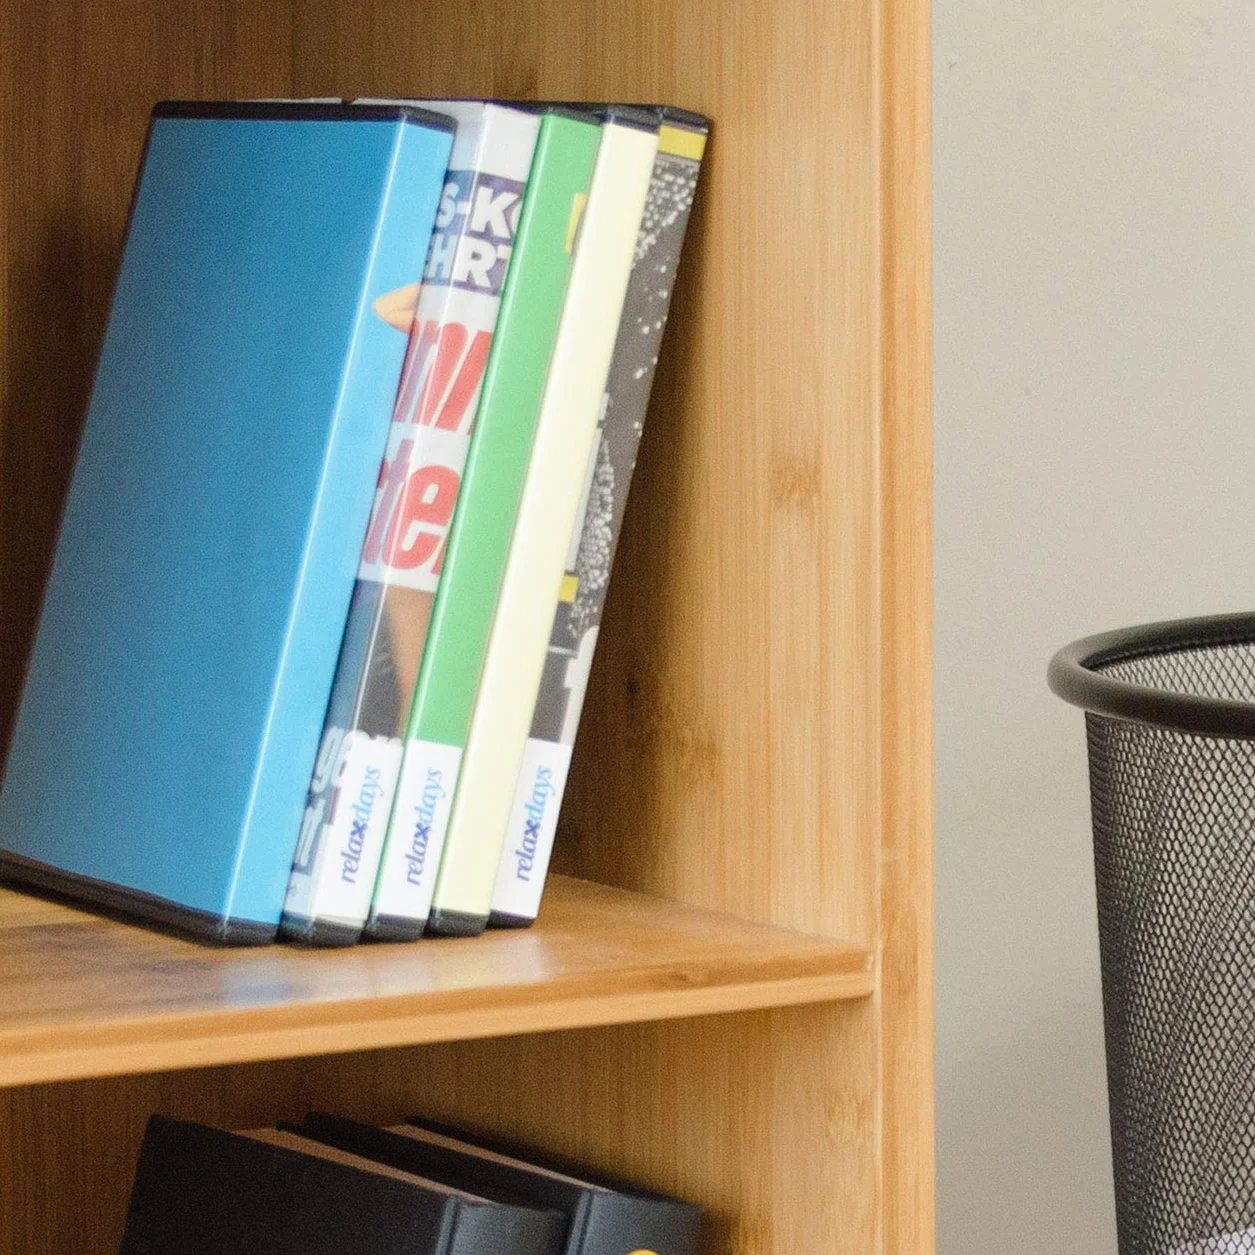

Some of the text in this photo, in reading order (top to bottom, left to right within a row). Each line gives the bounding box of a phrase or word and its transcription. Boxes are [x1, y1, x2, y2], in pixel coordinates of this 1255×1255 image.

[340, 764, 384, 884] relaxdays
[405, 766, 446, 886] relaxdays
[514, 764, 556, 882] relaxdays
